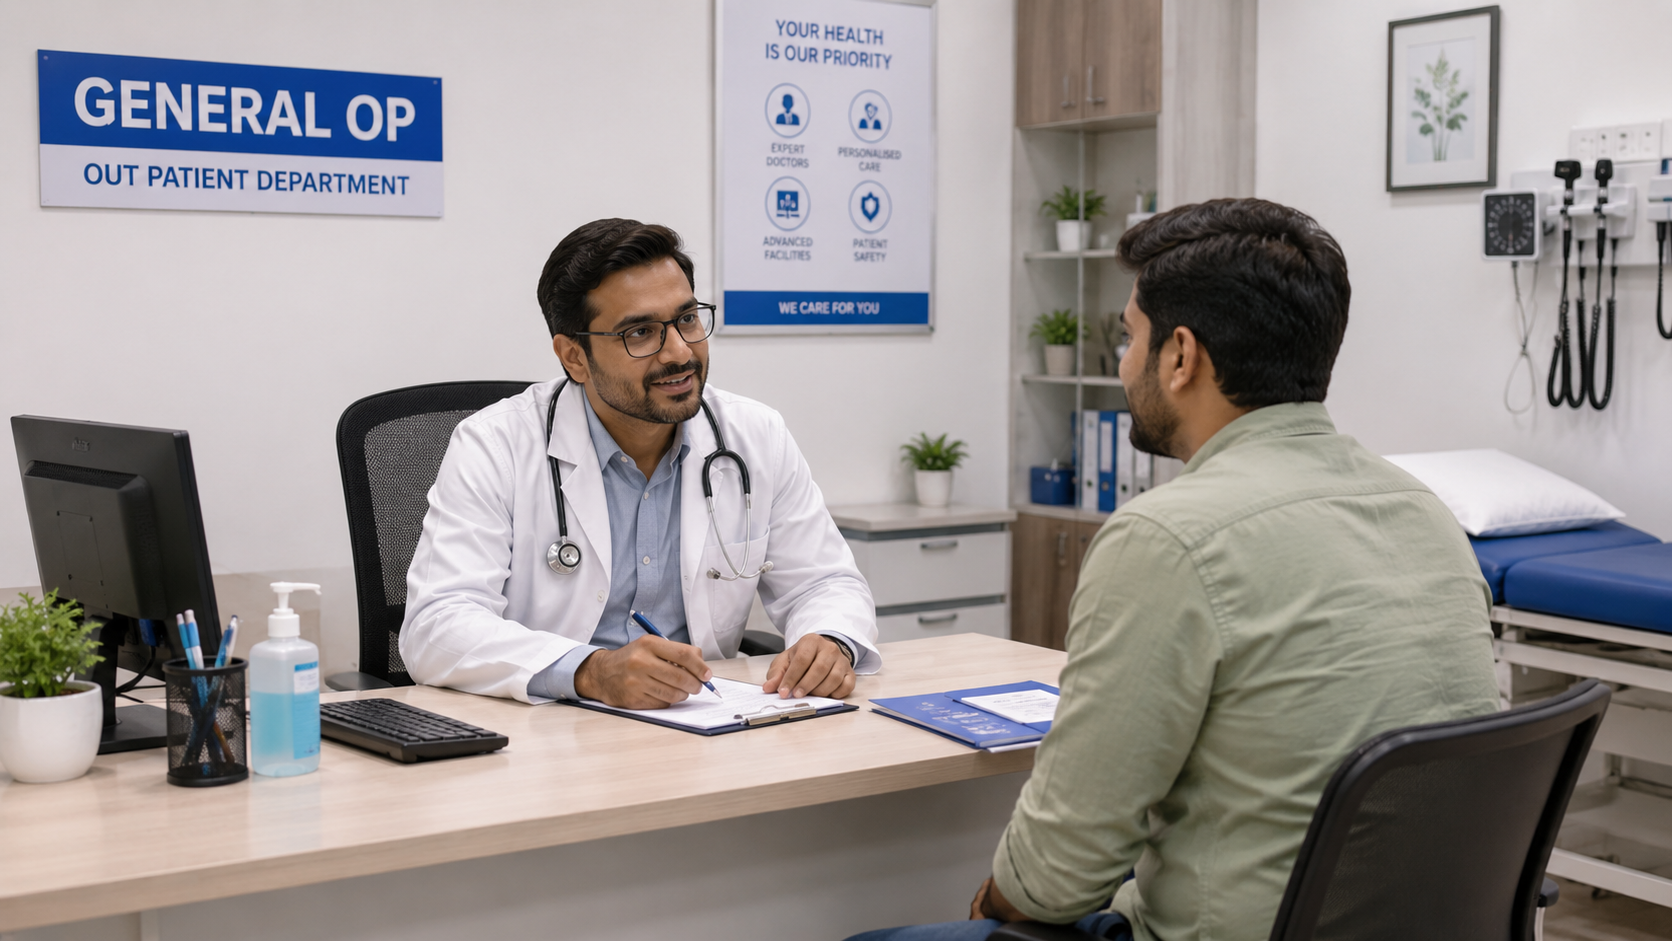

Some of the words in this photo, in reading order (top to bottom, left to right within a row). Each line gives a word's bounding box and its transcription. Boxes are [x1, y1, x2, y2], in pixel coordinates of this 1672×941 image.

[776, 20, 819, 39] YOUR
[825, 25, 883, 45] HEALTH
[766, 43, 780, 60] IS
[785, 45, 818, 63] OUR
[824, 49, 892, 69] PRIORITY
[74, 77, 332, 138] GENERAL
[346, 94, 416, 141] OP
[771, 143, 805, 154] EXPERT
[838, 147, 902, 160] PERSONALISED
[766, 157, 809, 168] DOCTORS
[859, 161, 881, 172] CARE
[83, 163, 139, 186] OUT
[147, 166, 249, 190] PATIENT
[257, 170, 410, 195] DEPARTMENT
[763, 236, 813, 247] ADVANCED
[853, 239, 888, 249] PATIENT
[764, 250, 811, 261] FACILITIES
[854, 252, 887, 262] SAFETY
[779, 302, 798, 314] WE
[800, 302, 830, 315] CARE
[832, 302, 855, 314] FOR
[856, 302, 880, 314] YOU
